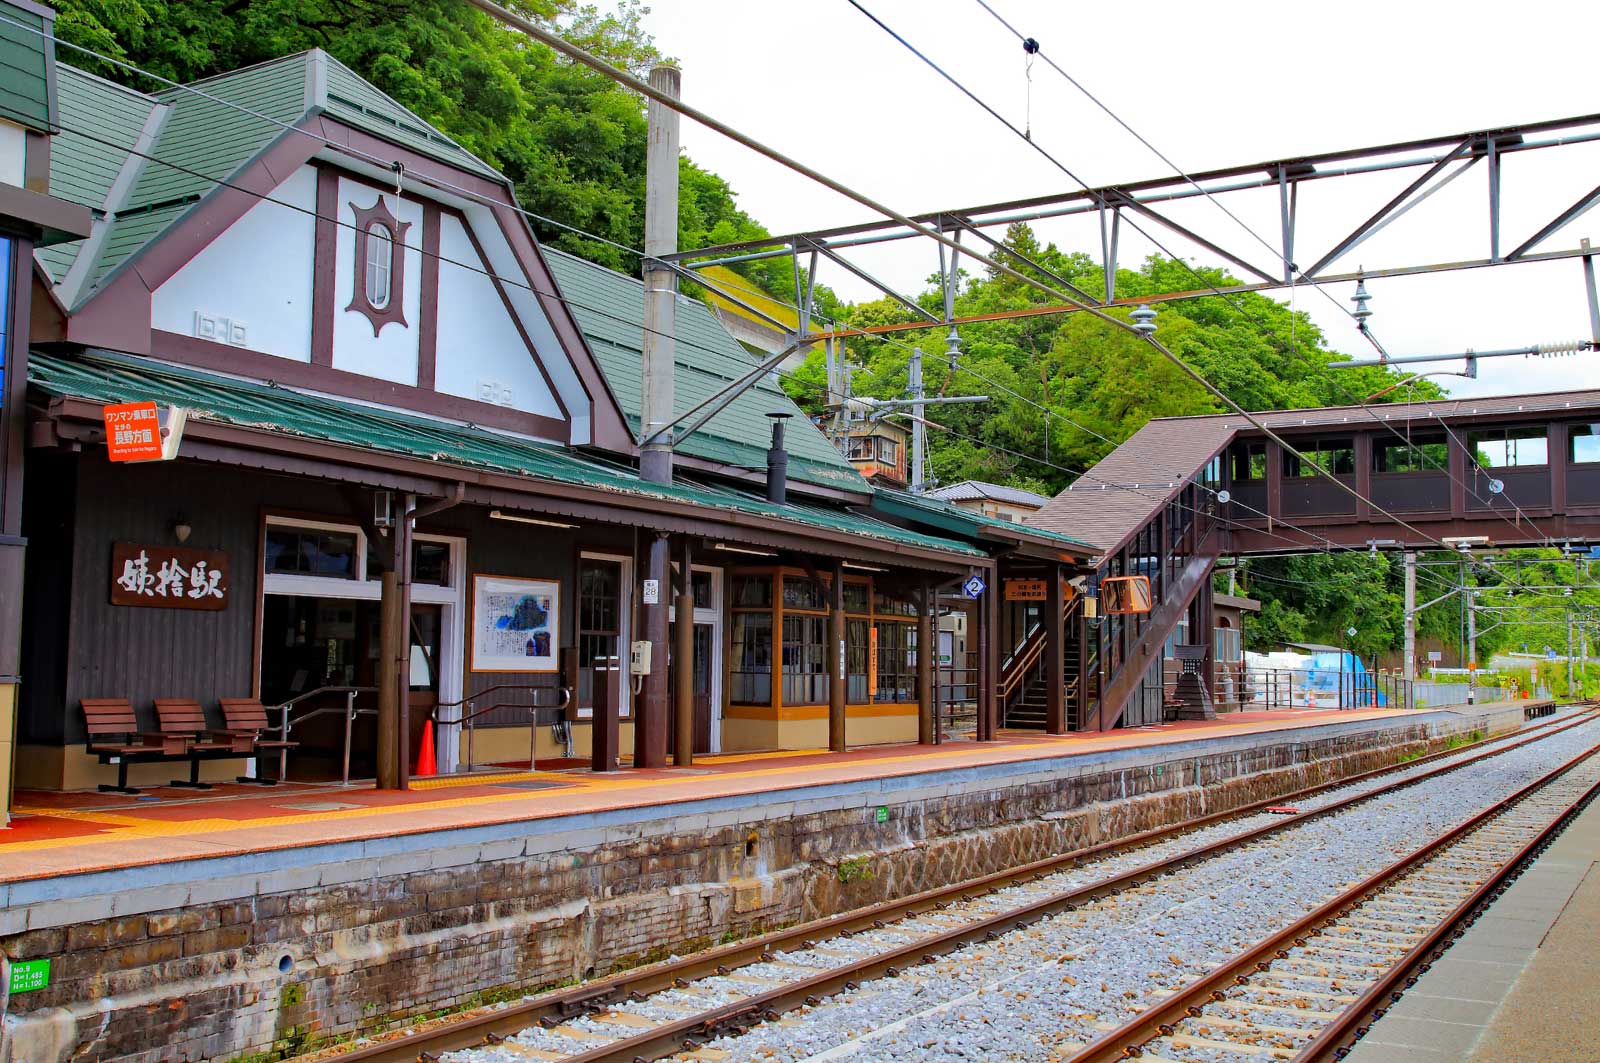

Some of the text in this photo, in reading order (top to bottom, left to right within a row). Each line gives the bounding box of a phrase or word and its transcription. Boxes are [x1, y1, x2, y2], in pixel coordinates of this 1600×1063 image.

[115, 428, 153, 445] 長野方面
[117, 550, 224, 599] 姨捨駅
[645, 587, 656, 596] 28
[970, 581, 979, 592] 2
